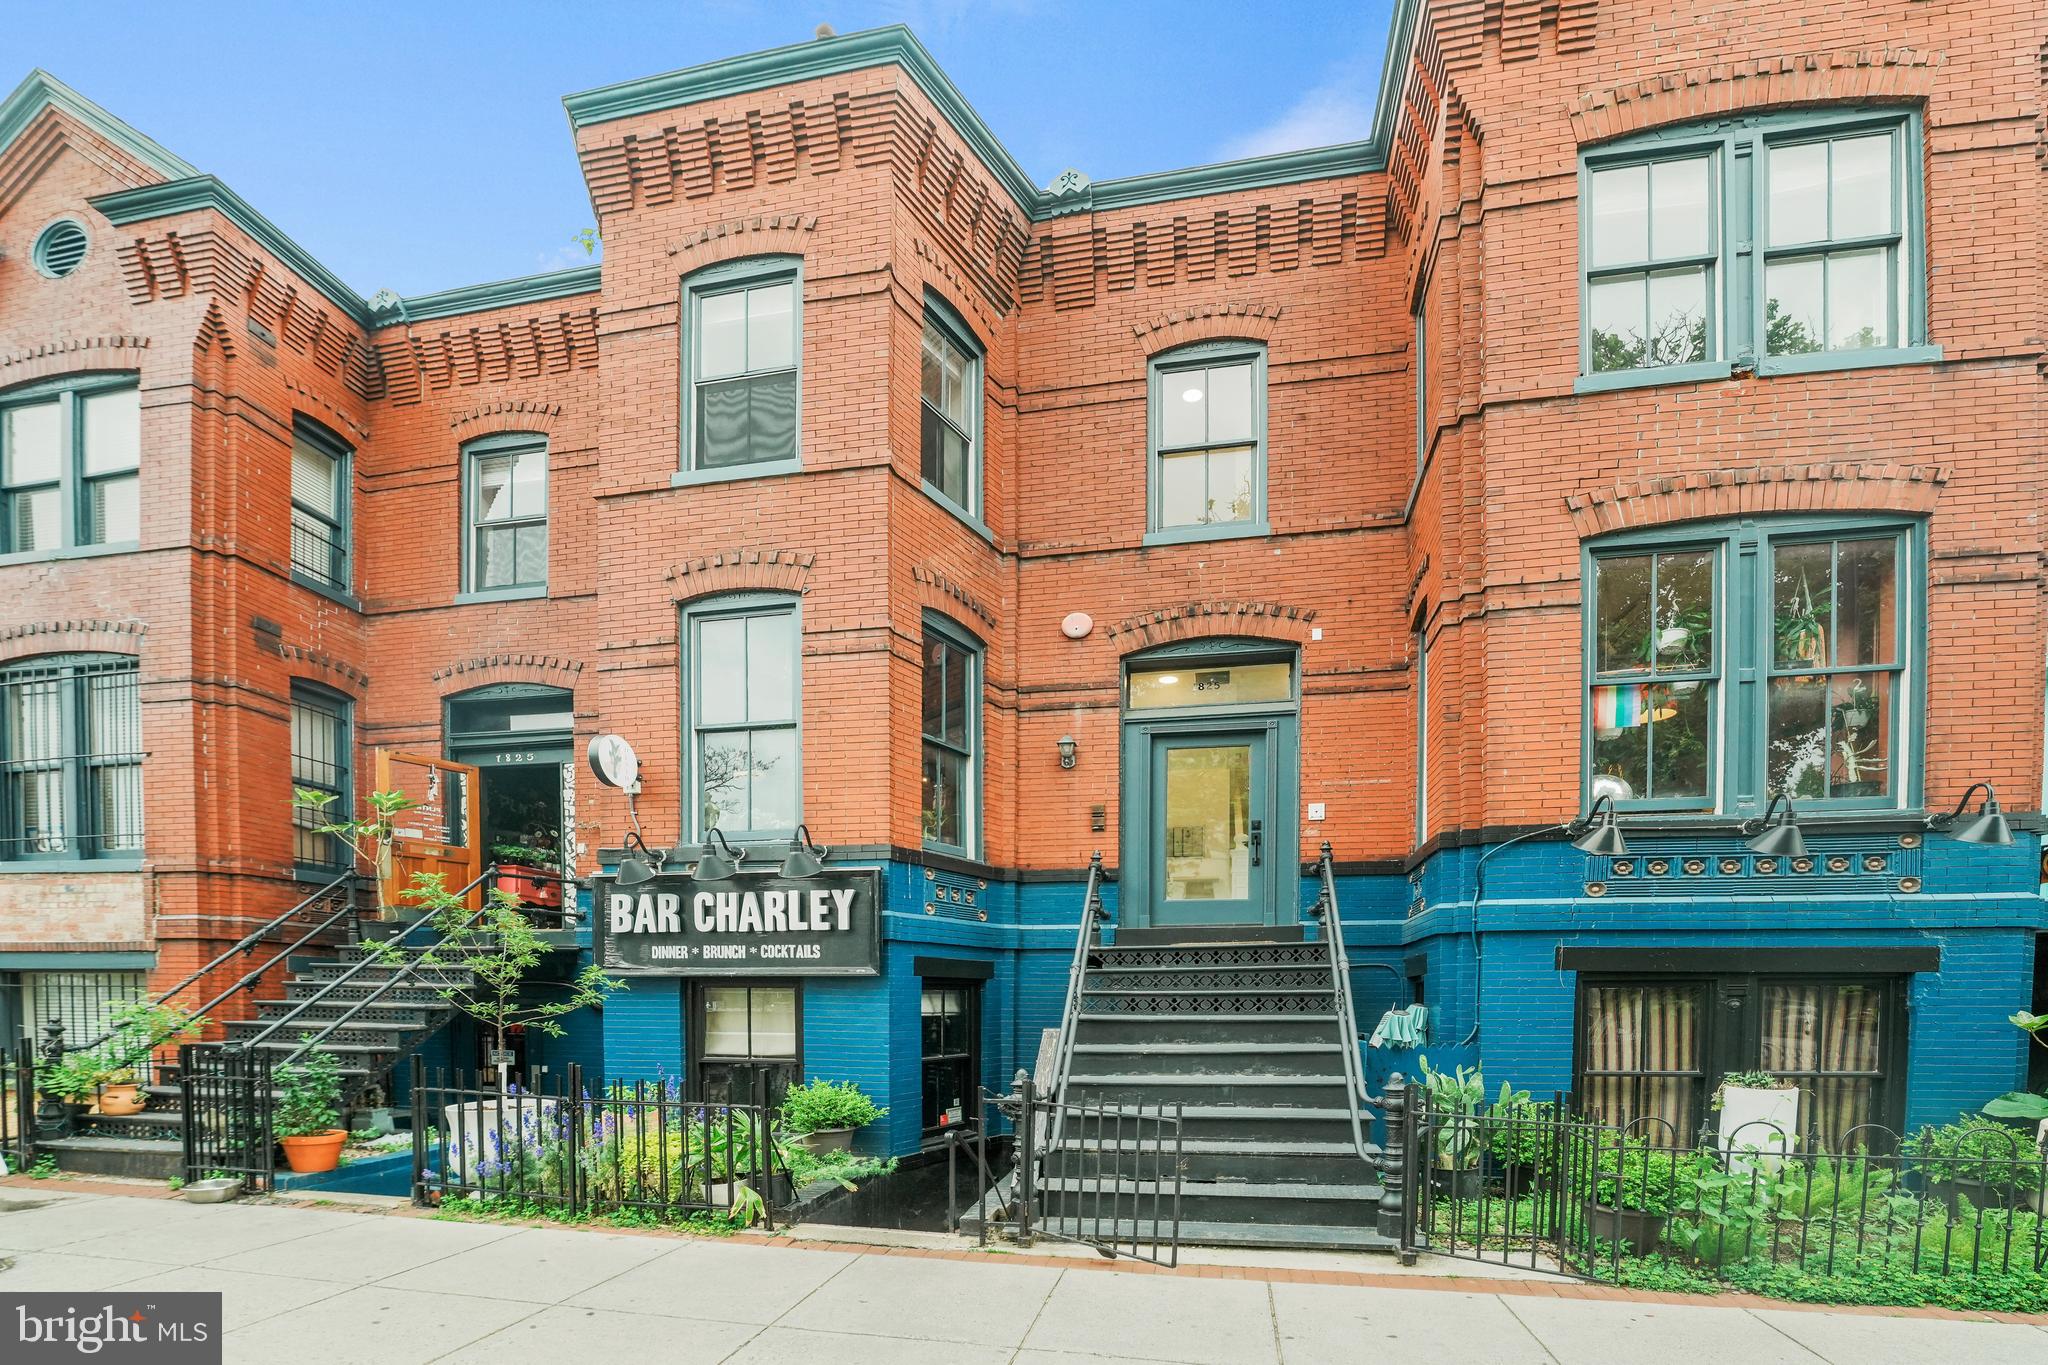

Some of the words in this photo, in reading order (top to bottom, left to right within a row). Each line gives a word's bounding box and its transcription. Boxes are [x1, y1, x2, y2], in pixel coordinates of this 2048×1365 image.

[496, 753, 534, 762] 1825
[610, 894, 681, 933] BAR
[694, 889, 855, 932] CHARLEY
[652, 945, 688, 959] DINNER
[703, 945, 746, 959] BRUNCH
[760, 944, 821, 959] COCKTAILS
